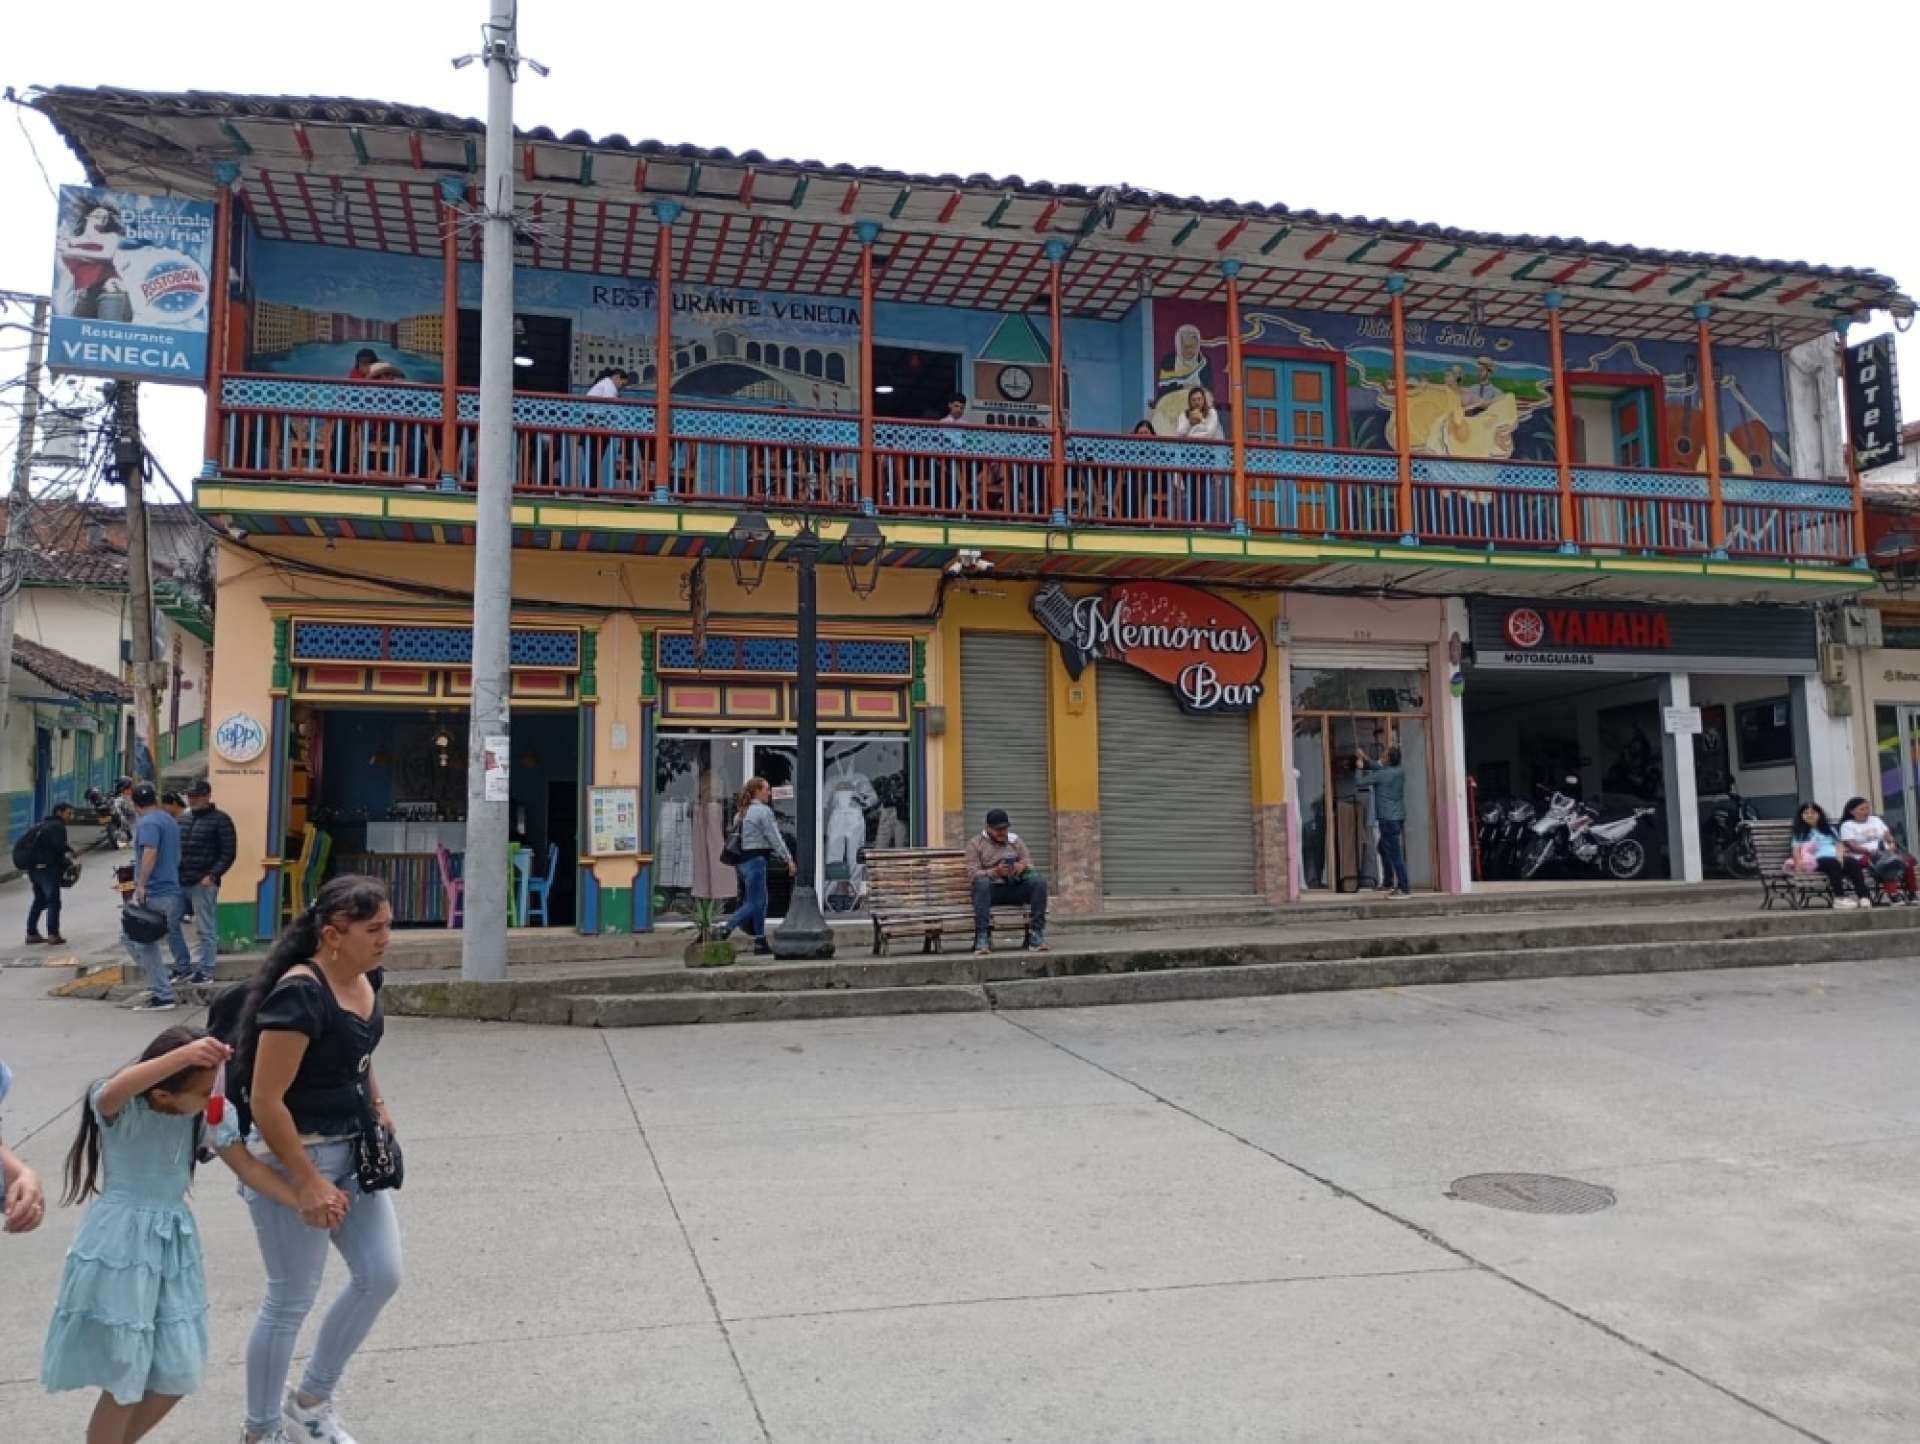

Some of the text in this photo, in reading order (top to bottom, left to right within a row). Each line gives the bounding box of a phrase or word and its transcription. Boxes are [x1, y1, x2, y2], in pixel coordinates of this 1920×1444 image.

[126, 224, 164, 241] bien
[592, 285, 861, 325] RESTURANTE VENECIA
[81, 324, 175, 345] Restaurante
[62, 340, 190, 370] VENECIA
[1857, 343, 1881, 449] HOTEL
[1072, 596, 1260, 652] Memorias
[1546, 609, 1673, 648] YAMAHA
[1504, 653, 1595, 665] MOTOAGUADAS
[1180, 660, 1262, 709] Bar
